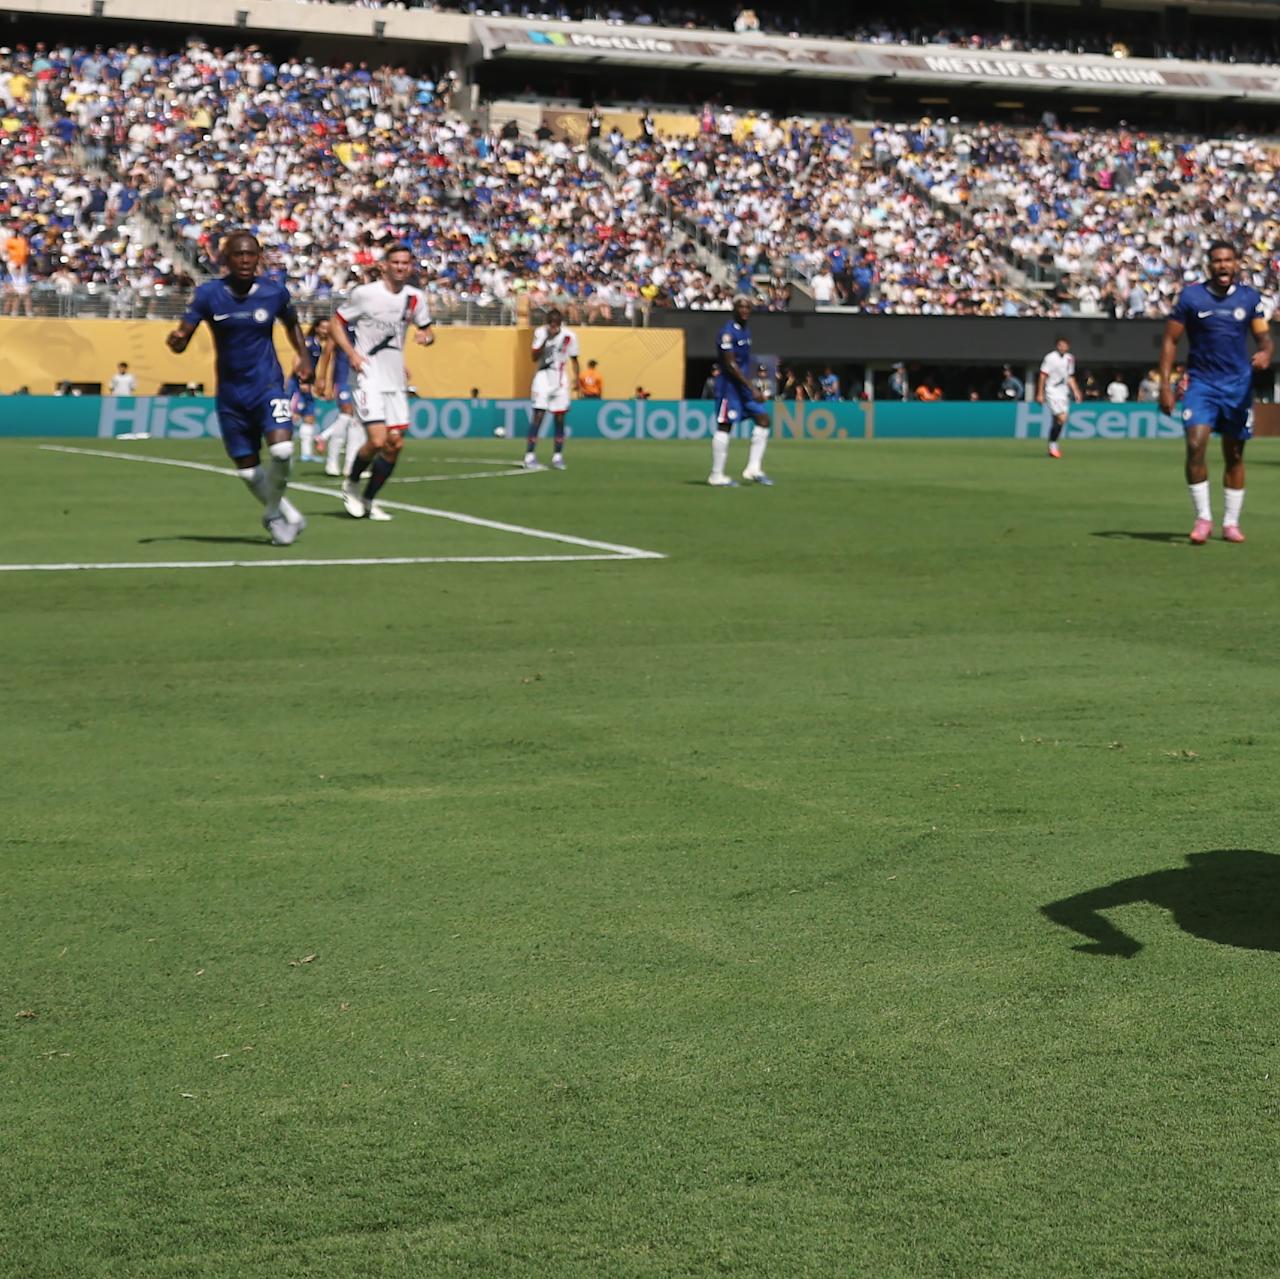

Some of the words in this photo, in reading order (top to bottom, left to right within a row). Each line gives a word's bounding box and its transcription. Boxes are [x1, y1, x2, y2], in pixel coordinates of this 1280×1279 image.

[570, 33, 673, 53] MetLife
[924, 56, 1043, 78] METLIFE
[1046, 64, 1166, 85] STADIUM
[270, 399, 291, 418] 23
[773, 403, 847, 439] No.
